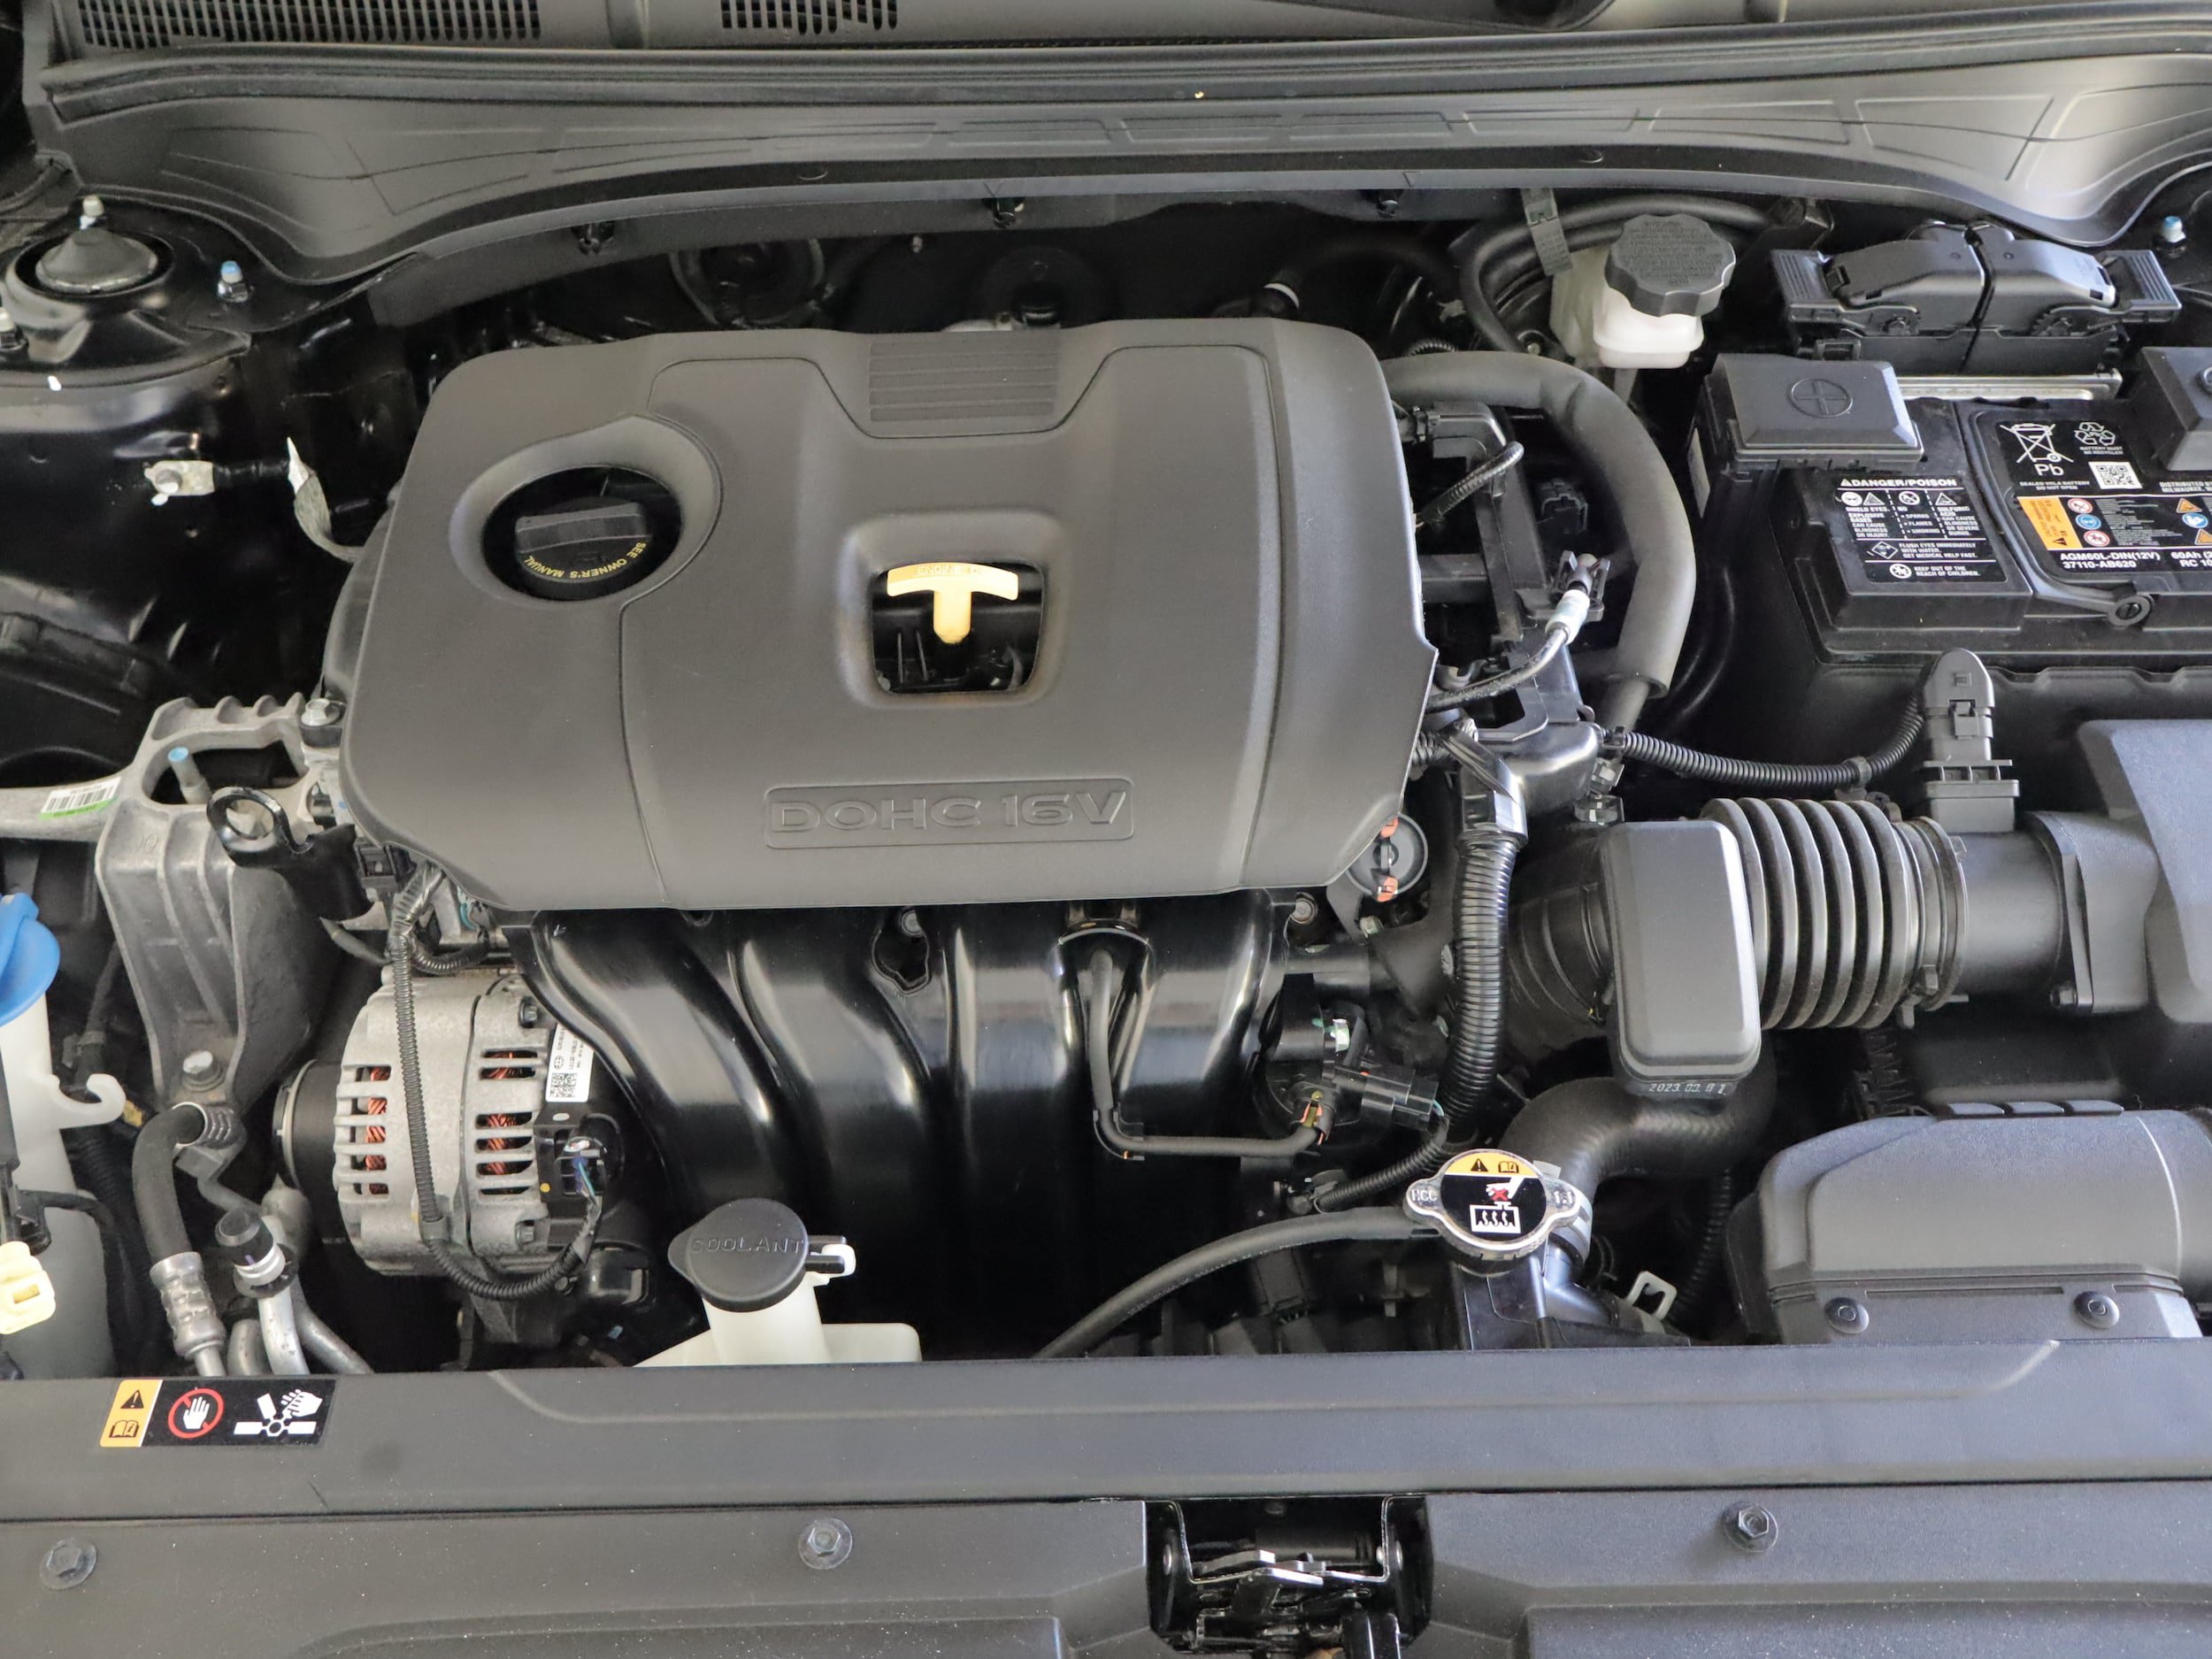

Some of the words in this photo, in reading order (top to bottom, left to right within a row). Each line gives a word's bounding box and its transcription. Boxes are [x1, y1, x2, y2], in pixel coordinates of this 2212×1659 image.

[2034, 464, 2064, 476] Pb
[626, 541, 647, 559] SEE
[2061, 552, 2161, 561] AGM60L-DIN(12V)
[524, 555, 565, 578] MANUAL
[569, 558, 627, 579] OWNER'S
[917, 565, 960, 574] ENGINE
[2062, 561, 2137, 569] 37110-AB620
[772, 796, 981, 833] DOHC
[1002, 791, 1126, 827] 16V
[692, 1237, 804, 1254] COOLANT
